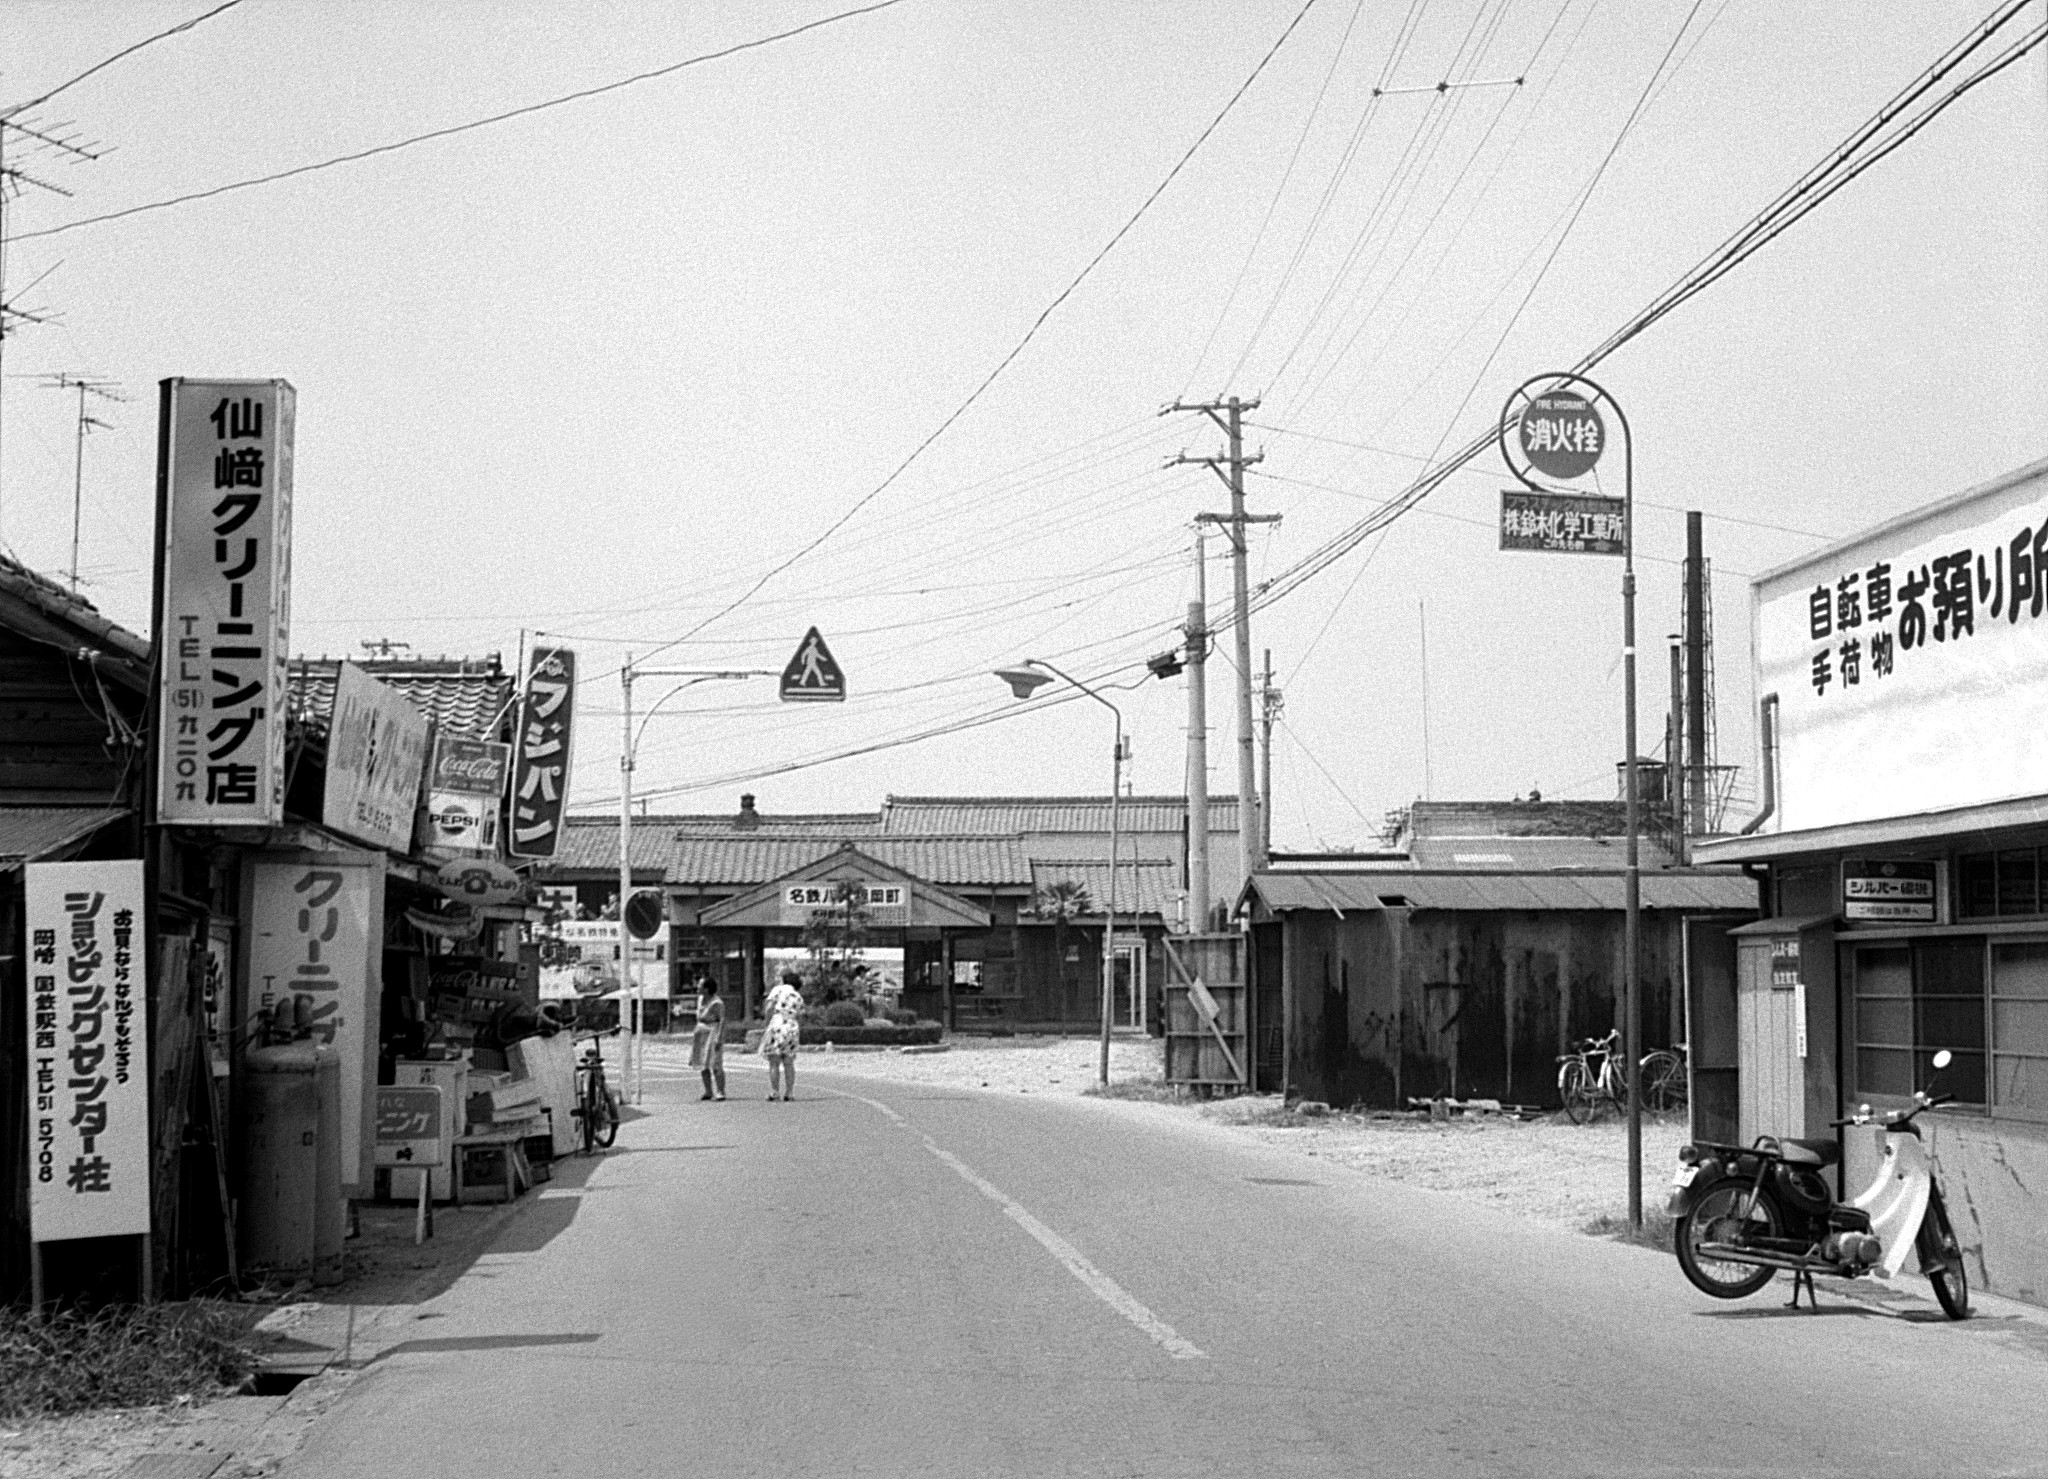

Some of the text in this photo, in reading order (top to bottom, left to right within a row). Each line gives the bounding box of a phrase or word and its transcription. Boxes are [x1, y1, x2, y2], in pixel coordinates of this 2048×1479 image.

[1526, 418, 1598, 452] 消火栓
[1810, 562, 1892, 640] 自転車
[1812, 631, 1893, 696] 手荷物
[515, 680, 568, 843] フジパン
[428, 814, 479, 827] PEPSI
[288, 871, 345, 1045] クリーニング
[63, 892, 111, 1194] ショッピングセンター桂
